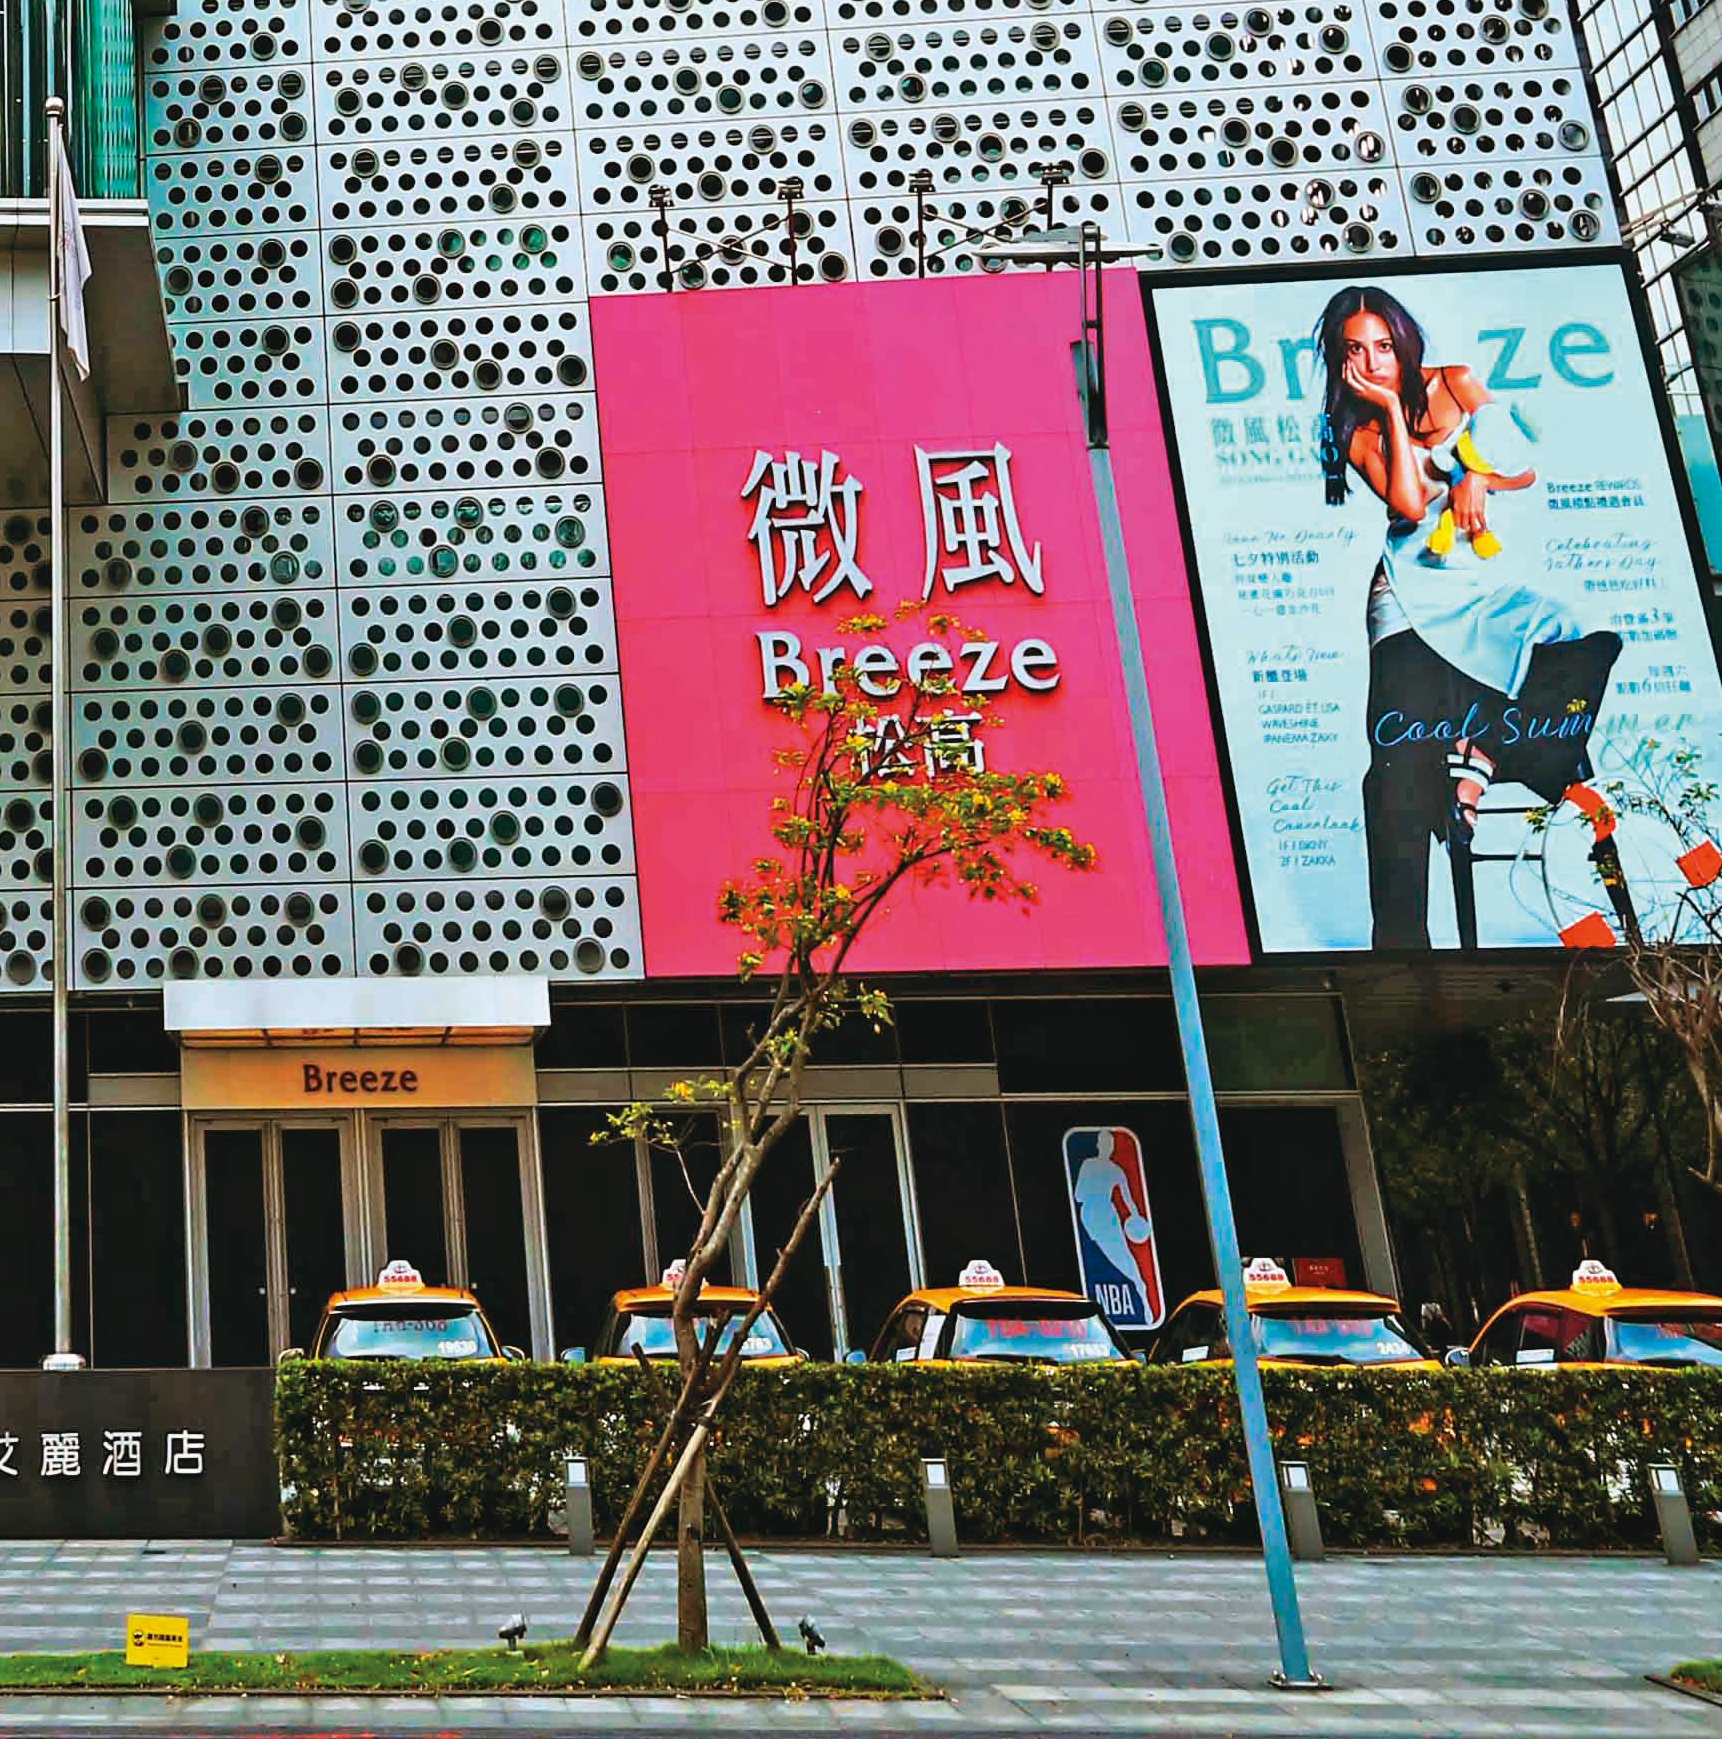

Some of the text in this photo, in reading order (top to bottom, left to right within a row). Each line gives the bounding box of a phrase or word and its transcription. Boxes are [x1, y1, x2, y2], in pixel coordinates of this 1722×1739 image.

[1190, 318, 1614, 404] Brze
[1546, 482, 1592, 493] Breeze
[740, 441, 1045, 607] 微風
[755, 630, 1060, 699] Breeze
[1374, 702, 1488, 746] Cool
[303, 1064, 418, 1094] Breeze
[383, 1275, 417, 1283] 55688
[1248, 1273, 1284, 1282] 55688
[1094, 1283, 1135, 1315] NBA
